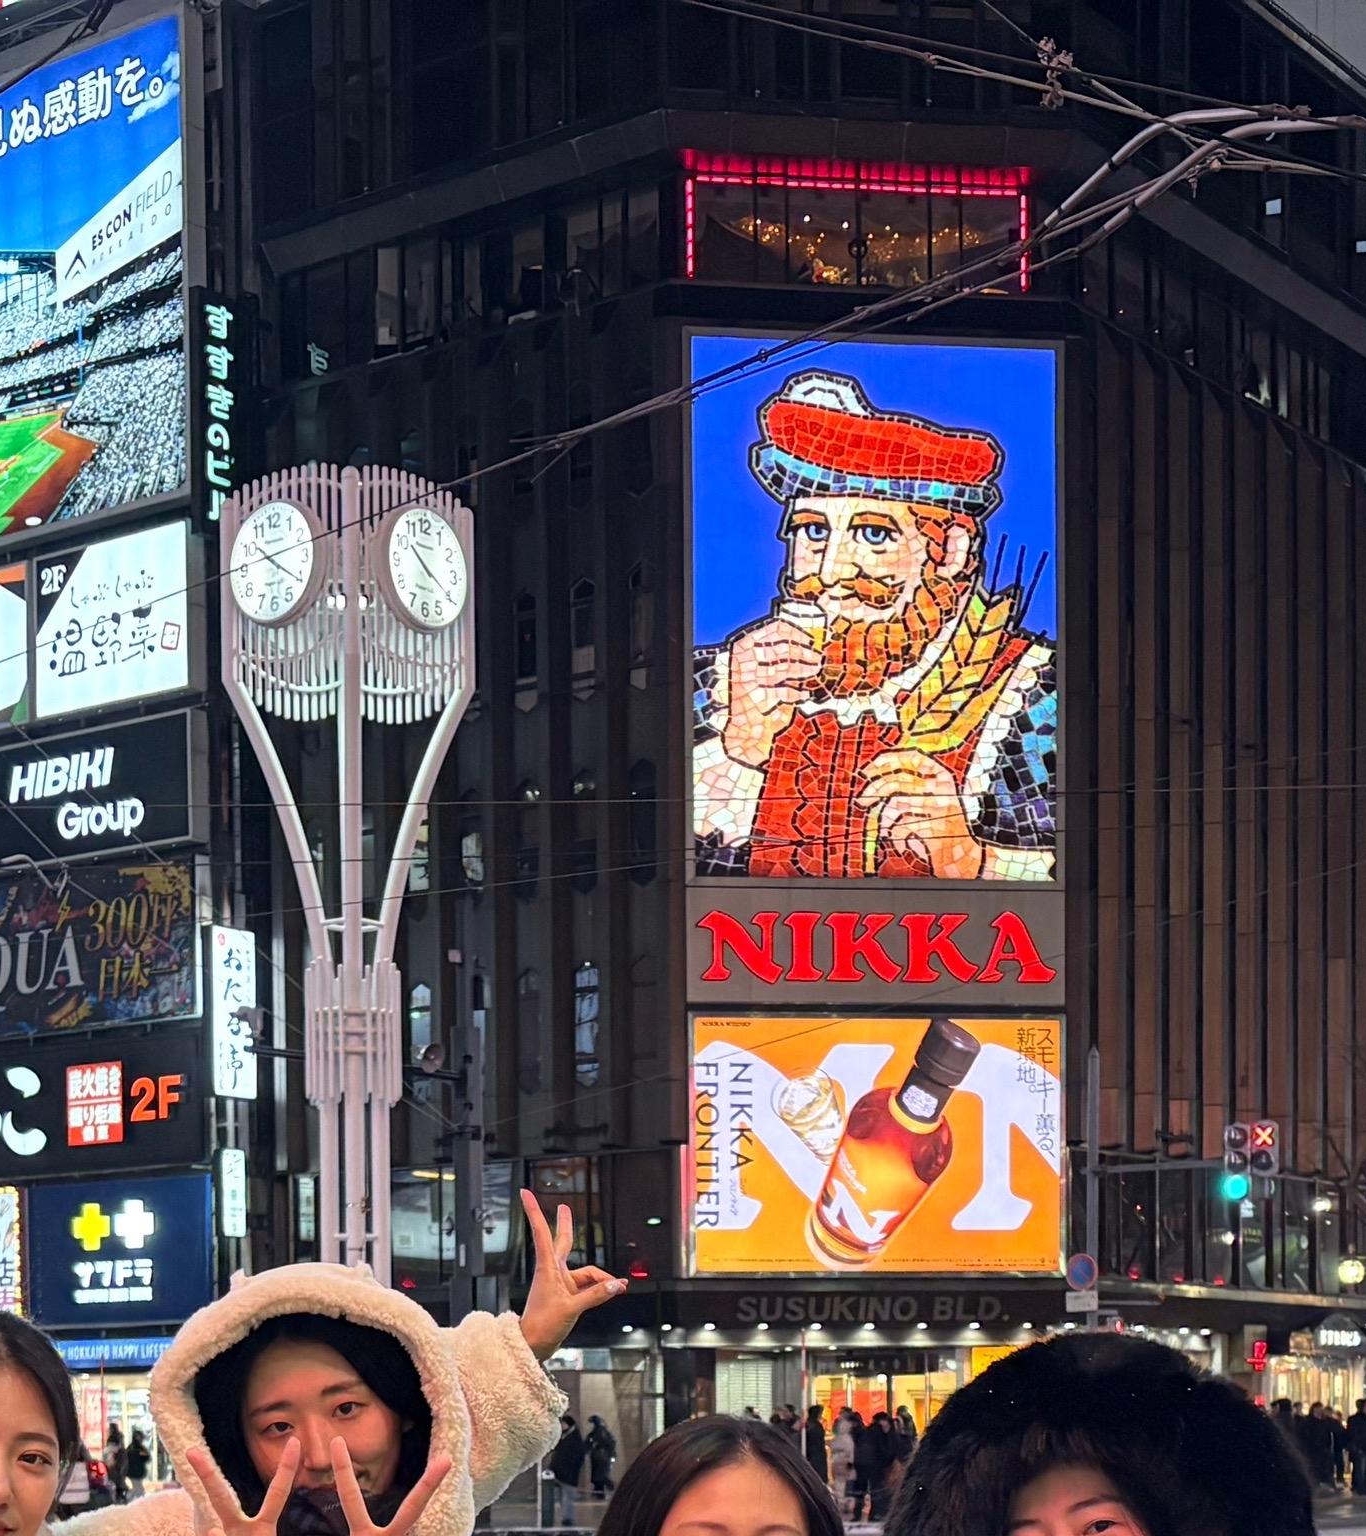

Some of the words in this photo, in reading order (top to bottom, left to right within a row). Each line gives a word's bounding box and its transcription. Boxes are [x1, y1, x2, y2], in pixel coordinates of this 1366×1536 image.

[135, 170, 173, 218] FIELD
[41, 564, 67, 595] 2F
[9, 747, 114, 803] HIBIKI
[56, 797, 145, 840] Group
[697, 909, 1058, 985] NIKKA
[99, 951, 179, 1002] 日本一
[1015, 1026, 1037, 1094] 新境地。
[130, 1074, 182, 1122] 2F
[729, 1061, 754, 1172] NIKKA
[1035, 1026, 1057, 1159] スモーキー薫る、
[695, 1061, 720, 1229] FRONTIER
[72, 1257, 154, 1288] サツドラ
[737, 1296, 918, 1322] SUSUKINO
[938, 1296, 1011, 1322] BLD.
[111, 1344, 138, 1360] HAPPY
